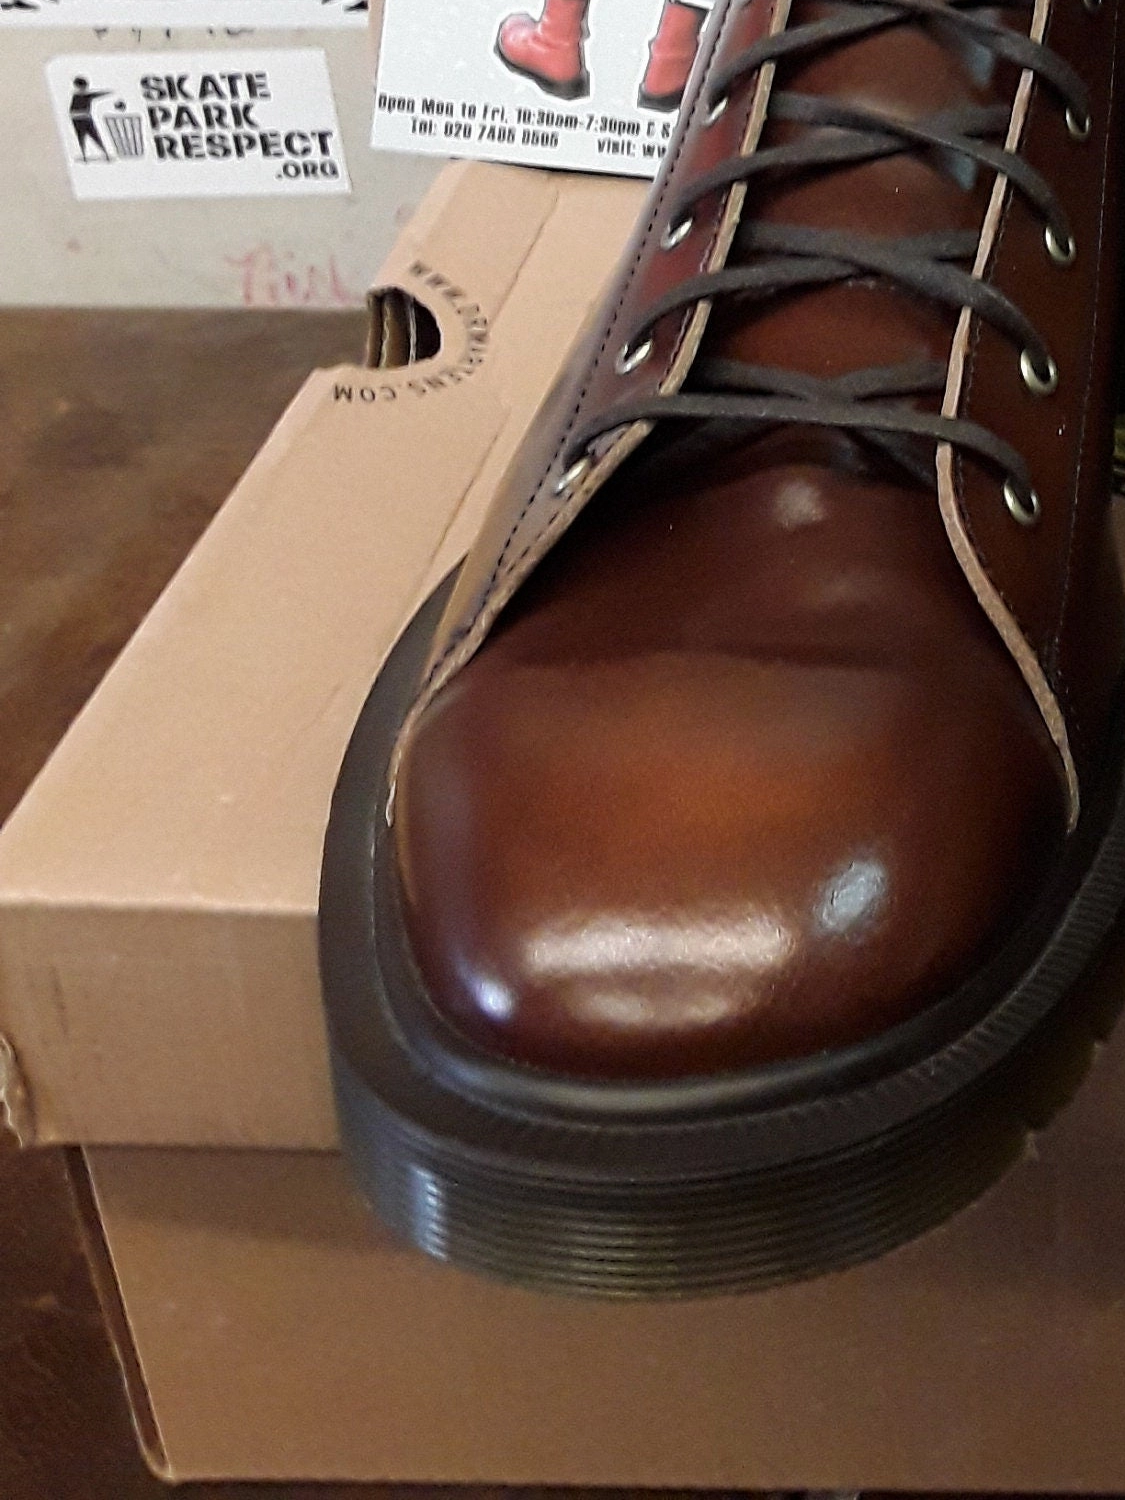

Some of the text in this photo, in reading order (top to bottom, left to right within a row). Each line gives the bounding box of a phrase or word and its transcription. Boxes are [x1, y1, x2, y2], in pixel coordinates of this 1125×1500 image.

[141, 72, 271, 100] SKATE
[148, 102, 257, 131] PARK
[421, 98, 454, 117] Mon
[461, 102, 477, 118] to
[155, 131, 334, 160] RESPECT
[276, 160, 339, 180] .ORG
